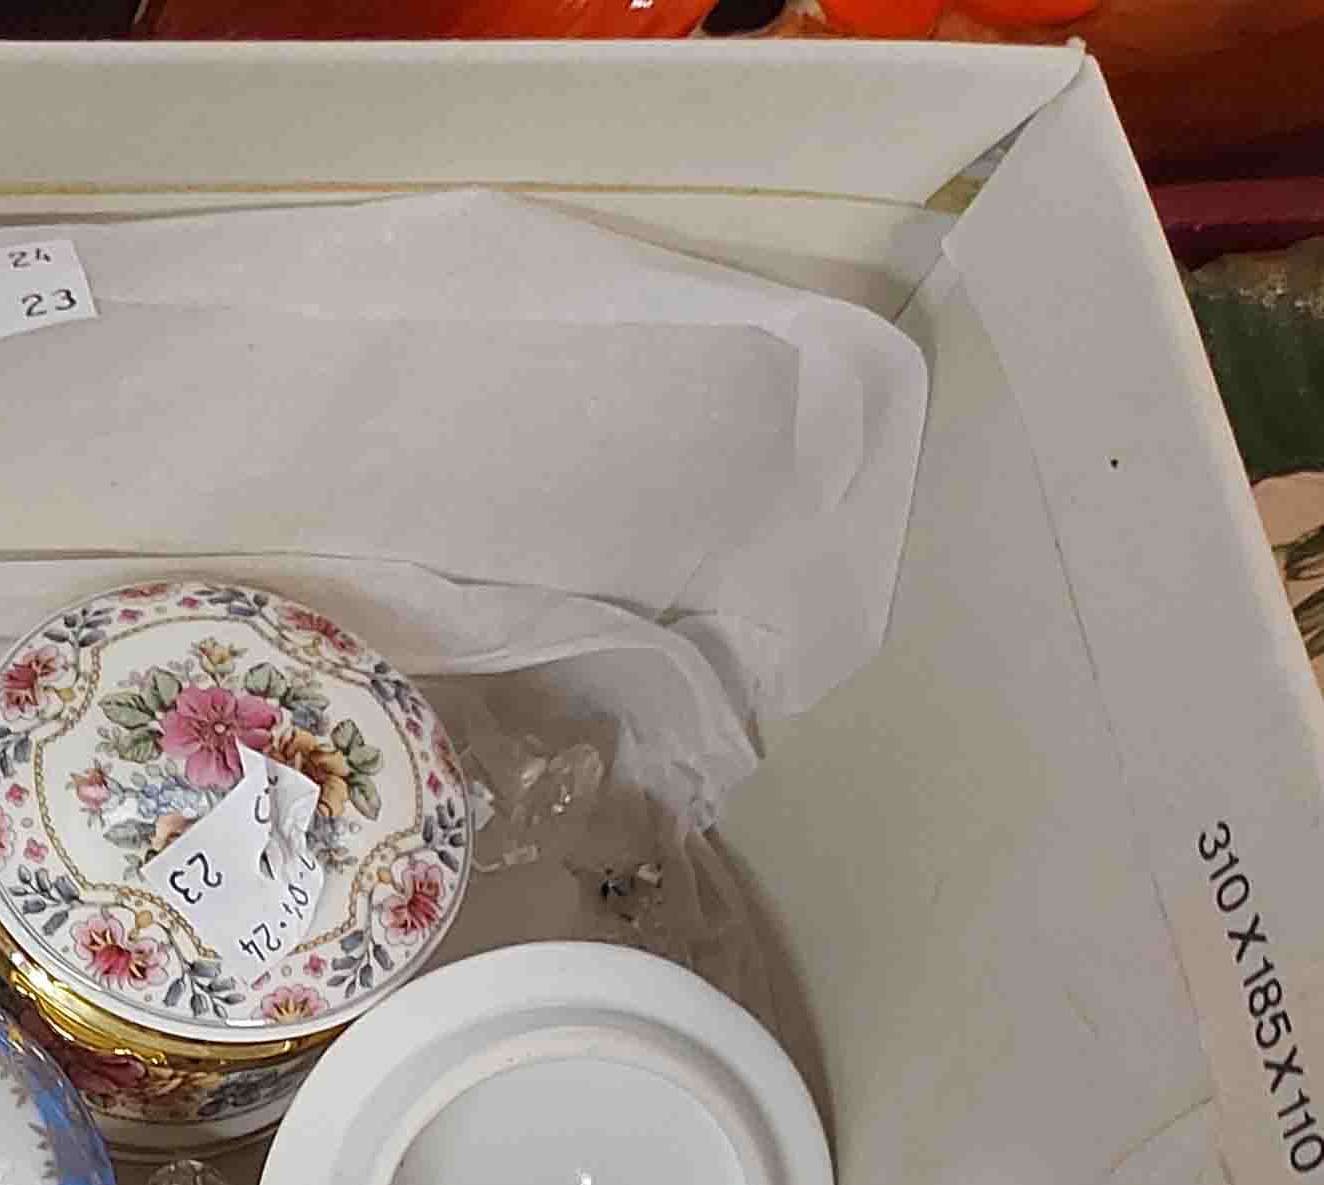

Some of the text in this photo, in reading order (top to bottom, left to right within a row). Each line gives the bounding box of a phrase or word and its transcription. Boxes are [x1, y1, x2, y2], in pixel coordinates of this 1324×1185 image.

[21, 288, 77, 318] 23
[168, 852, 222, 904] 23
[1198, 821, 1250, 912] 310
[1243, 956, 1292, 1050] 185
[1277, 1088, 1324, 1174] 110
